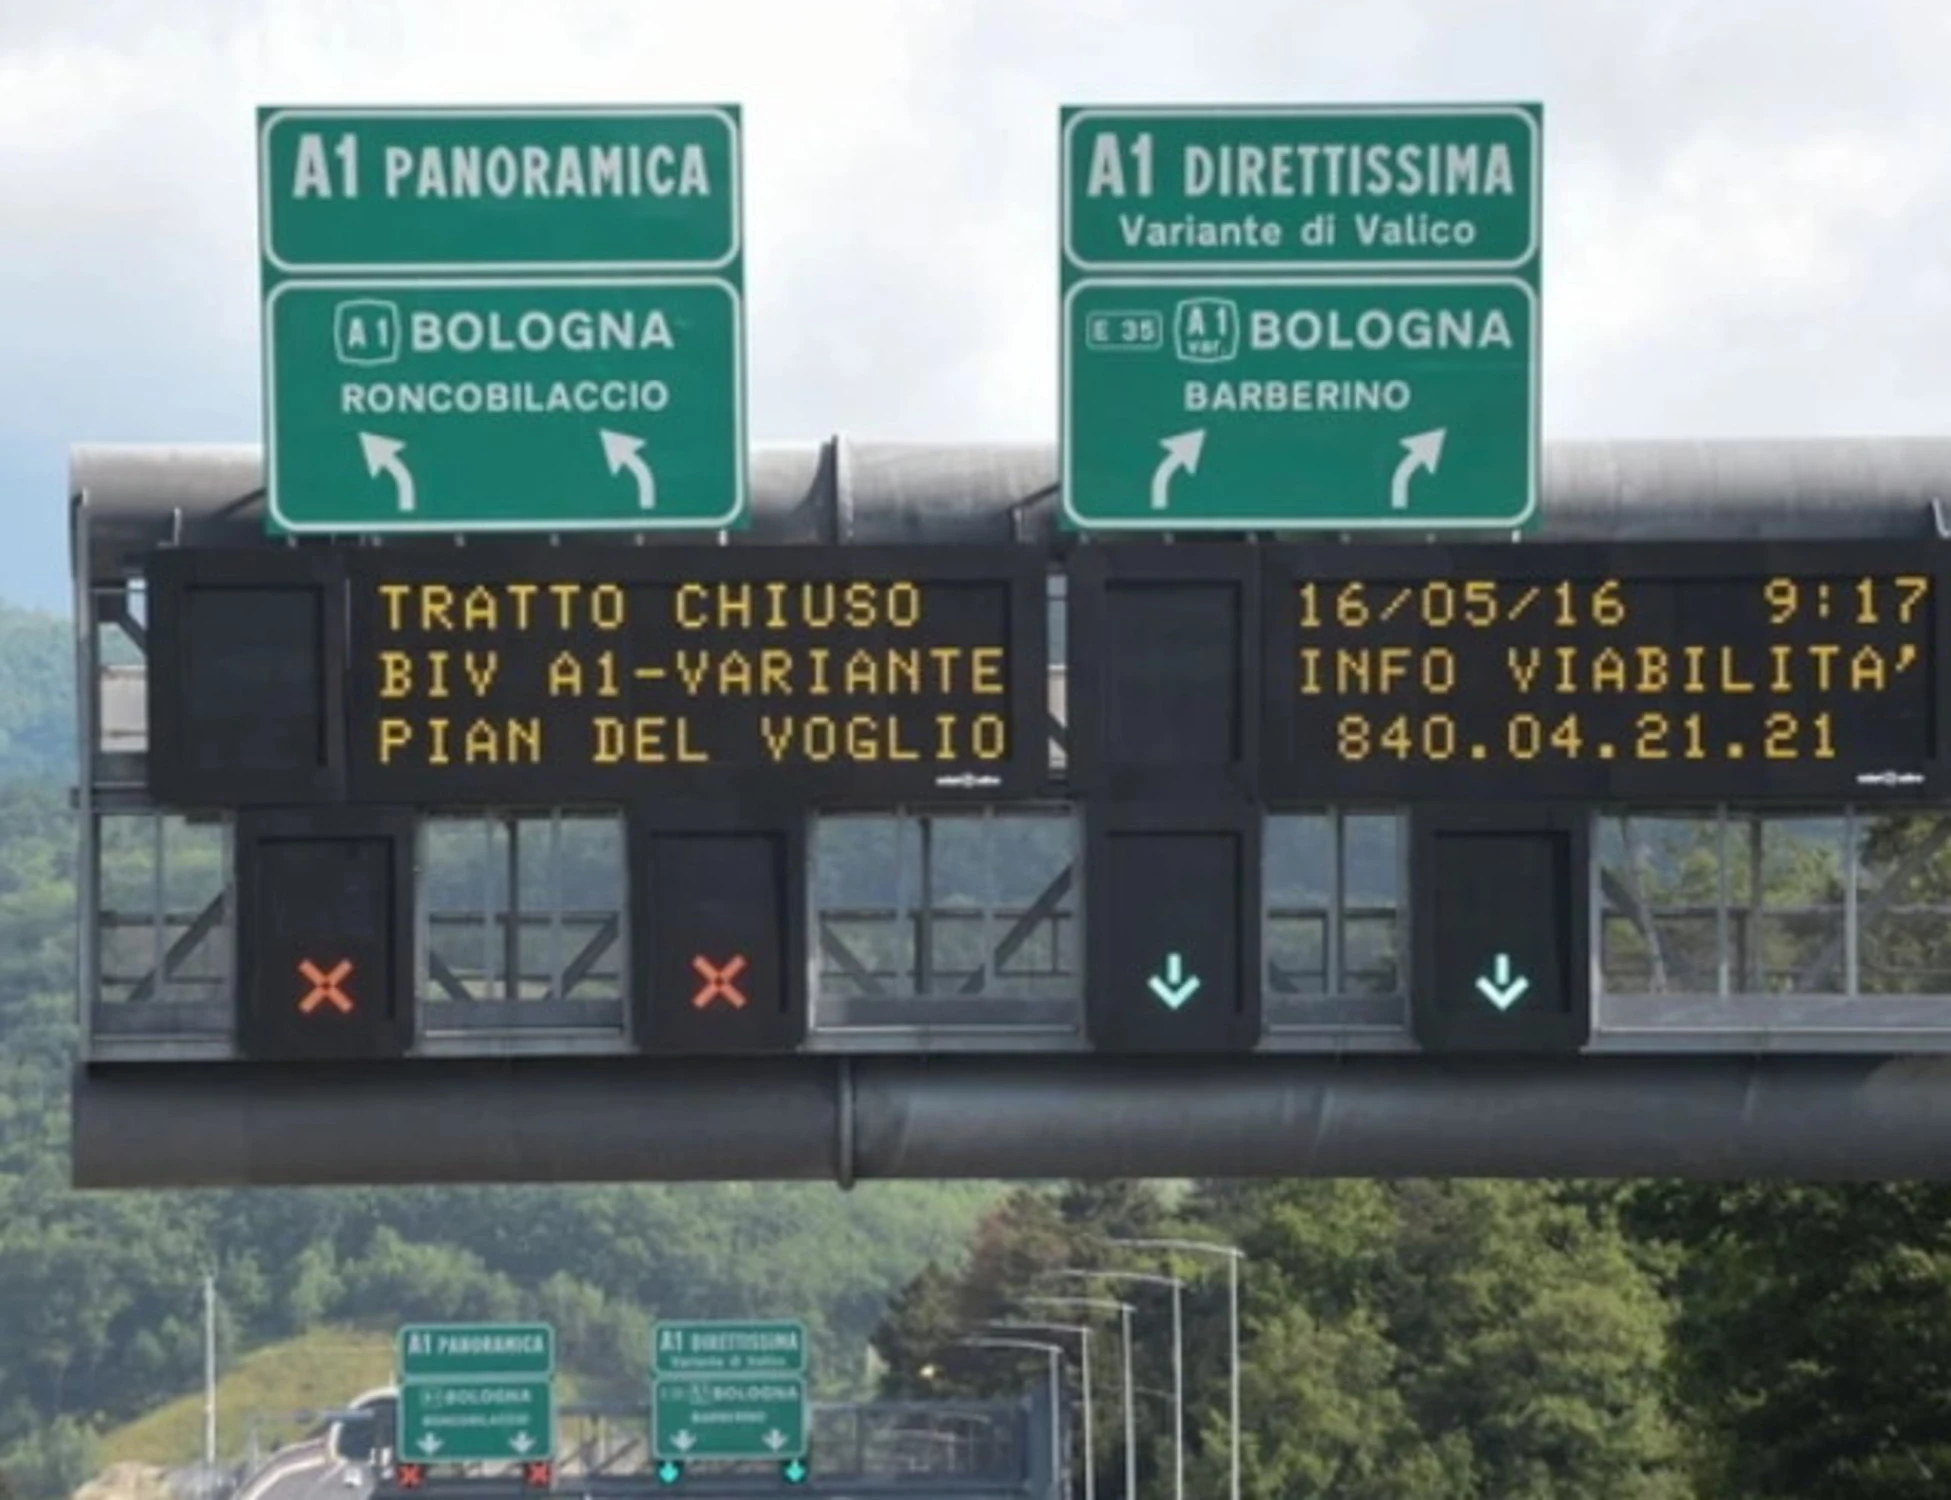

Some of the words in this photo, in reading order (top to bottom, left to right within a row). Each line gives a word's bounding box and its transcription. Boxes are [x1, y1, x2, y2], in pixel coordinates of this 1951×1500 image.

[294, 134, 357, 197] A1
[386, 145, 709, 197] PANORAMICA
[1088, 133, 1152, 196] A1
[1185, 144, 1513, 196] DIRETTISSIMA
[1120, 215, 1281, 246] Variante
[1301, 214, 1334, 245] di
[1356, 214, 1475, 245] Valico
[412, 311, 673, 351] BOLOGNA
[1251, 310, 1511, 349] BOLOGNA
[342, 380, 668, 412] RONCOBILACCIO
[1185, 381, 1410, 410] BARBERINO
[380, 585, 623, 629] TRATTO
[677, 582, 918, 628] CHIUSO
[1301, 580, 1624, 627] 16/05/16
[1765, 577, 1927, 623] 9:17
[380, 652, 496, 697] BIV
[550, 648, 1002, 696] A1-VARIANTE
[1302, 648, 1454, 693] INFO
[381, 719, 539, 763] PIAN
[594, 717, 708, 762] DEL
[762, 715, 1003, 760] VOGLIO
[1338, 713, 1834, 760] 840.04.21.21
